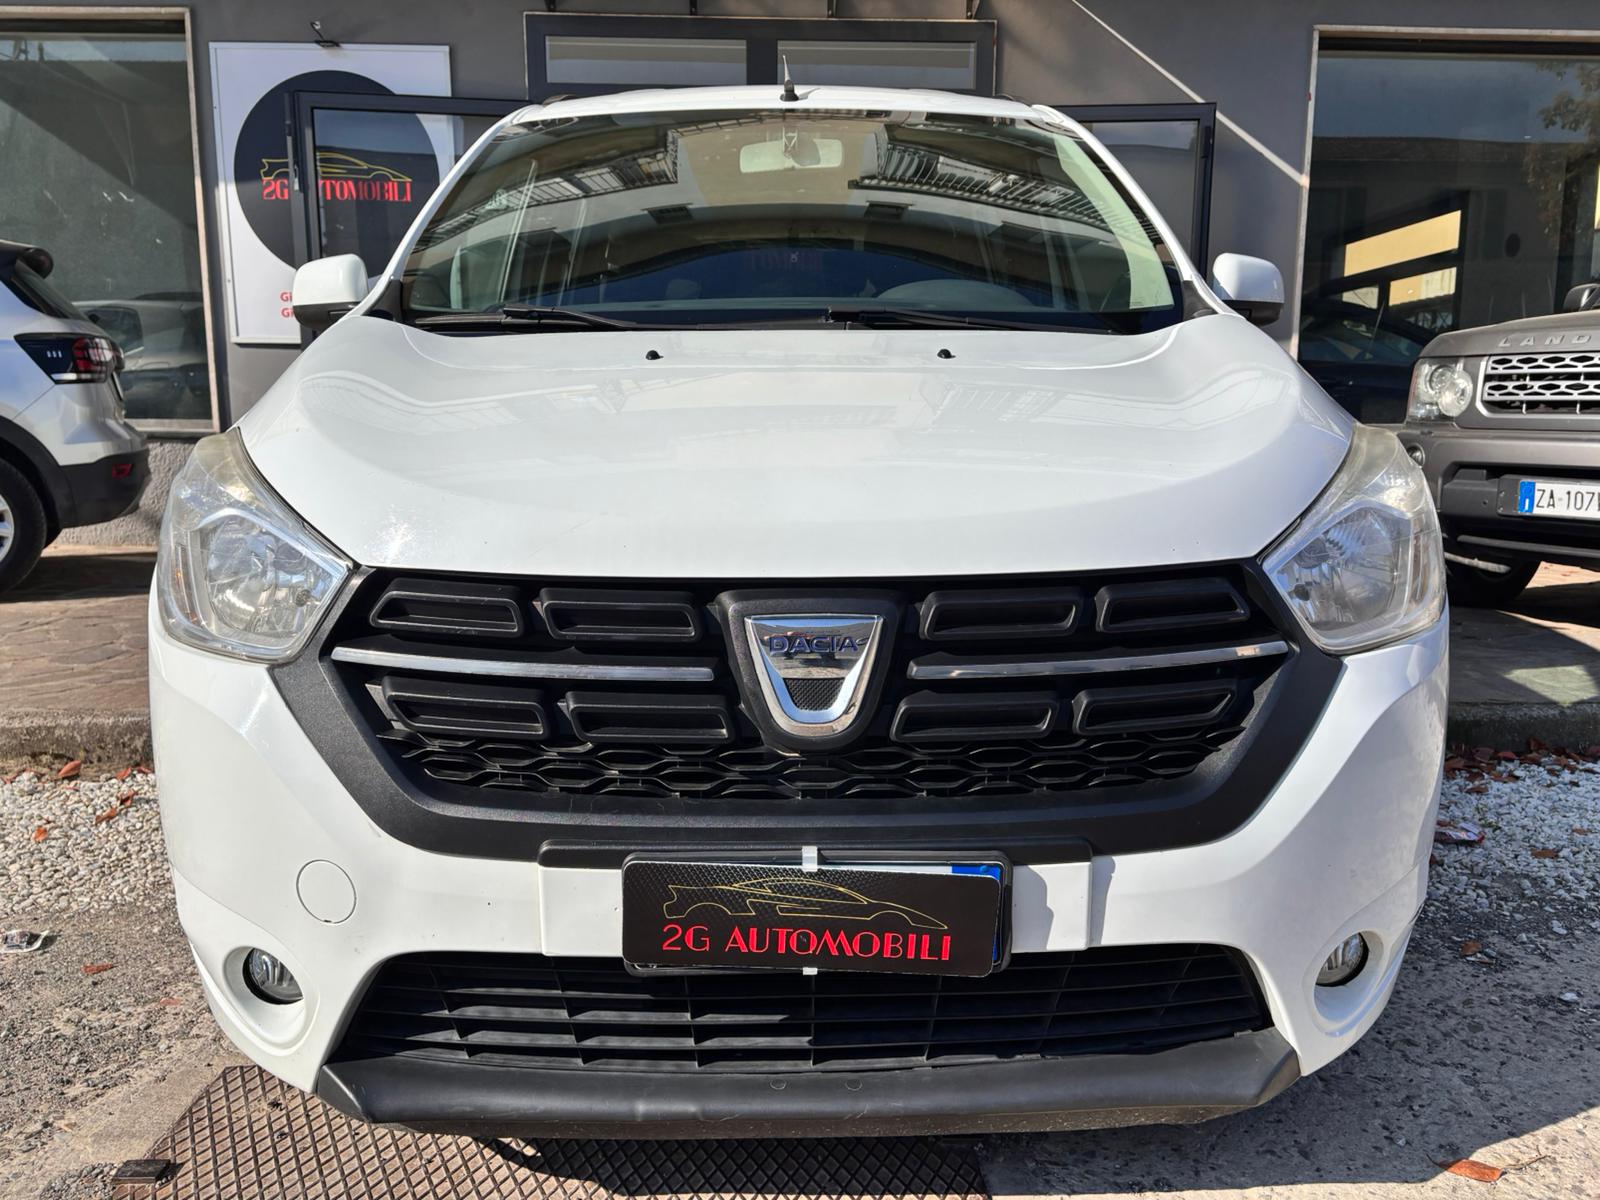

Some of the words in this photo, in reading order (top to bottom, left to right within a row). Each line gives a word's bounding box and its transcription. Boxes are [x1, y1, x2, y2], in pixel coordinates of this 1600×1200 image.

[1498, 334, 1592, 348] LAND
[1566, 490, 1600, 512] 107
[769, 636, 859, 653] DACIA
[661, 924, 711, 951] 2G
[724, 925, 952, 961] AUTOMOBILI
